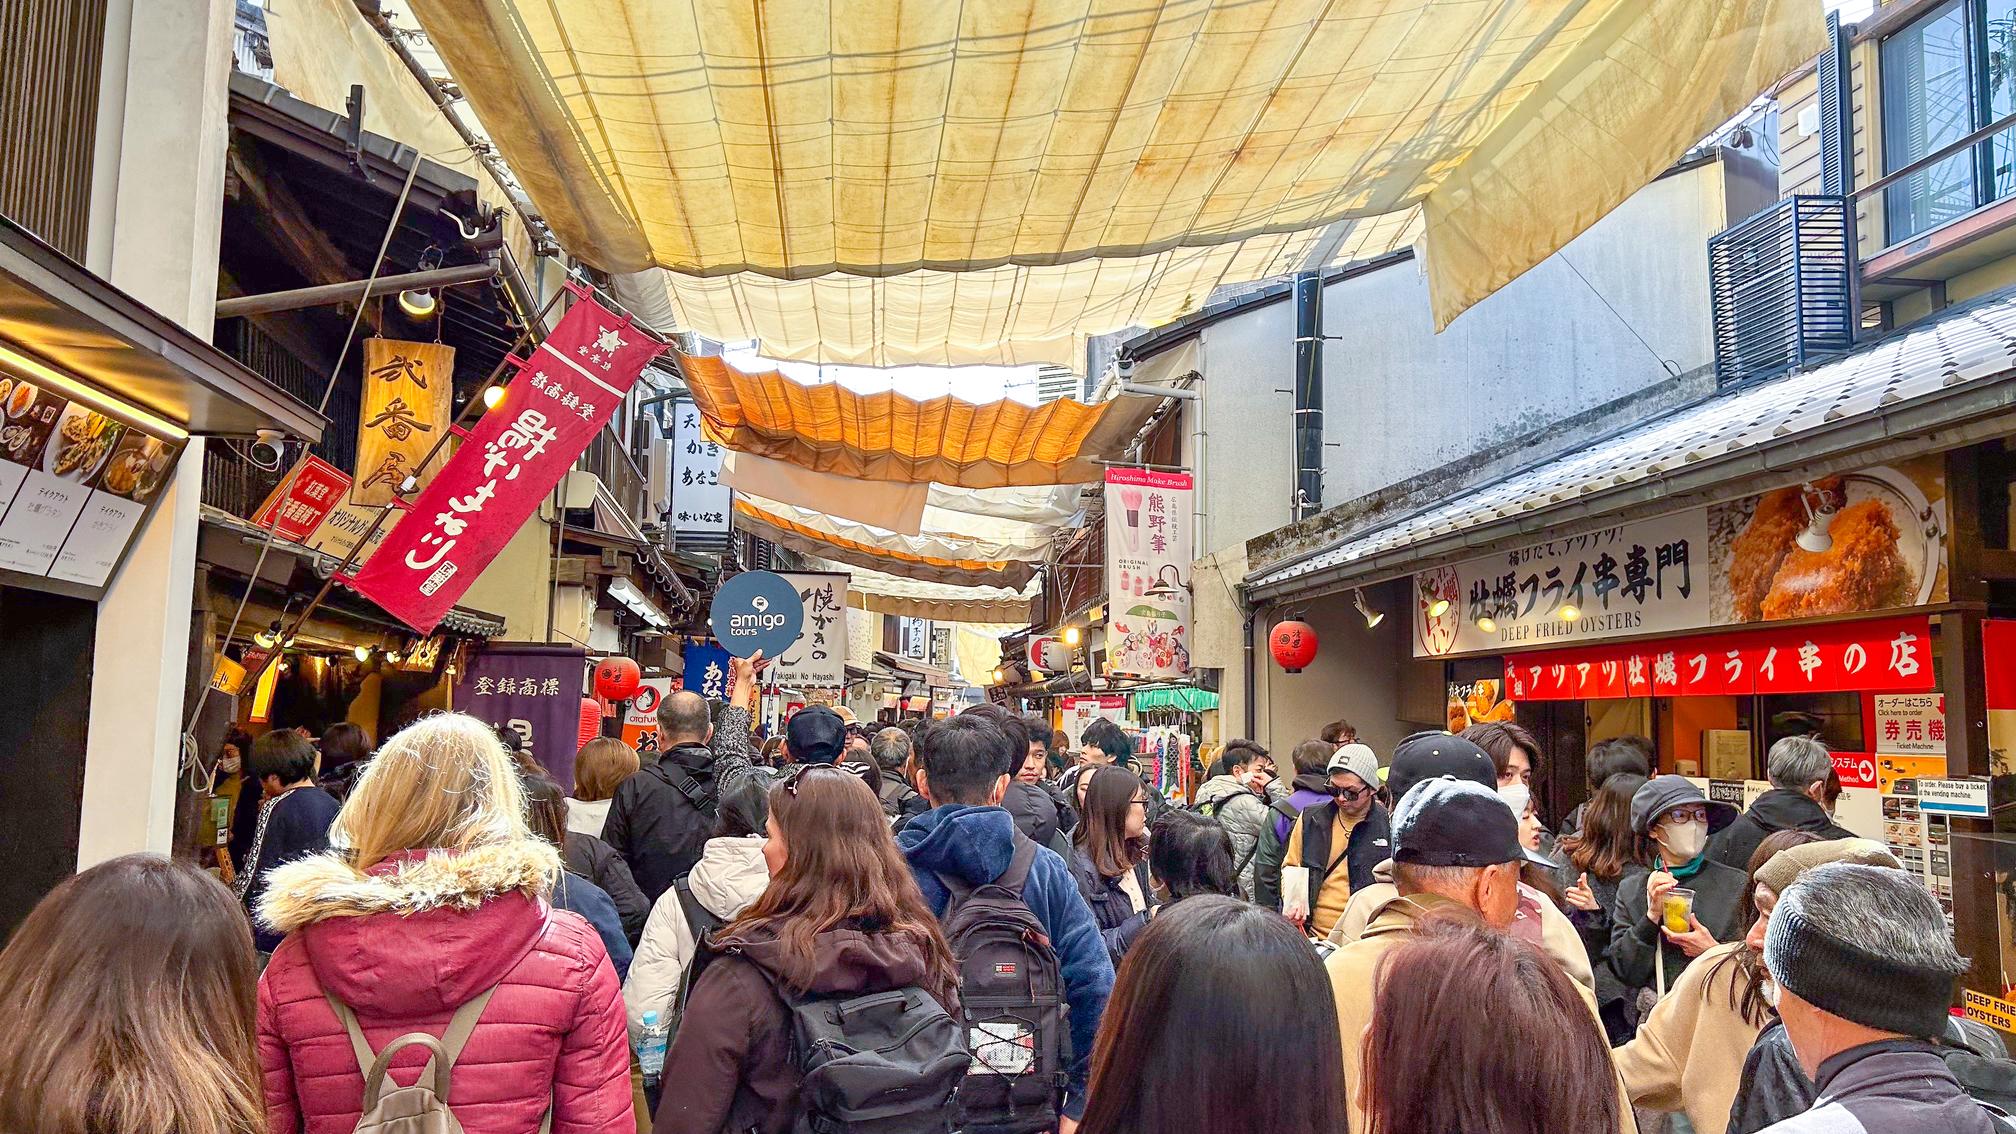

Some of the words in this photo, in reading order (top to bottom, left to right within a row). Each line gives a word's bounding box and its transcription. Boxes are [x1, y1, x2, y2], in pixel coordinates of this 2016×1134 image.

[686, 439, 719, 457] かき
[1111, 473, 1146, 483] Hiroshima
[1147, 476, 1165, 485] Make
[1167, 479, 1187, 487] Brush
[1148, 492, 1167, 555] 熊野筆
[1469, 538, 1690, 625] 牡蠣フライ串専門
[730, 613, 785, 631] amigo
[731, 626, 757, 637] tours
[1501, 624, 1531, 642] DEEP
[1536, 618, 1573, 638] FRIED
[1580, 611, 1642, 633] OYSTERS
[1530, 632, 1919, 689] アツアツ牡蠣フライ串の店
[474, 676, 560, 697] 登録商標
[702, 660, 723, 700] あな
[800, 672, 809, 681] No
[812, 672, 835, 682] Hayashi
[1506, 661, 1523, 696] 元祖
[1878, 698, 1933, 707] オーダーはこちら
[1885, 719, 1945, 741] 券売機
[1896, 742, 1911, 750] Ticket
[1967, 992, 1991, 1007] DEEP
[1967, 1007, 2011, 1029] OYSTERS
